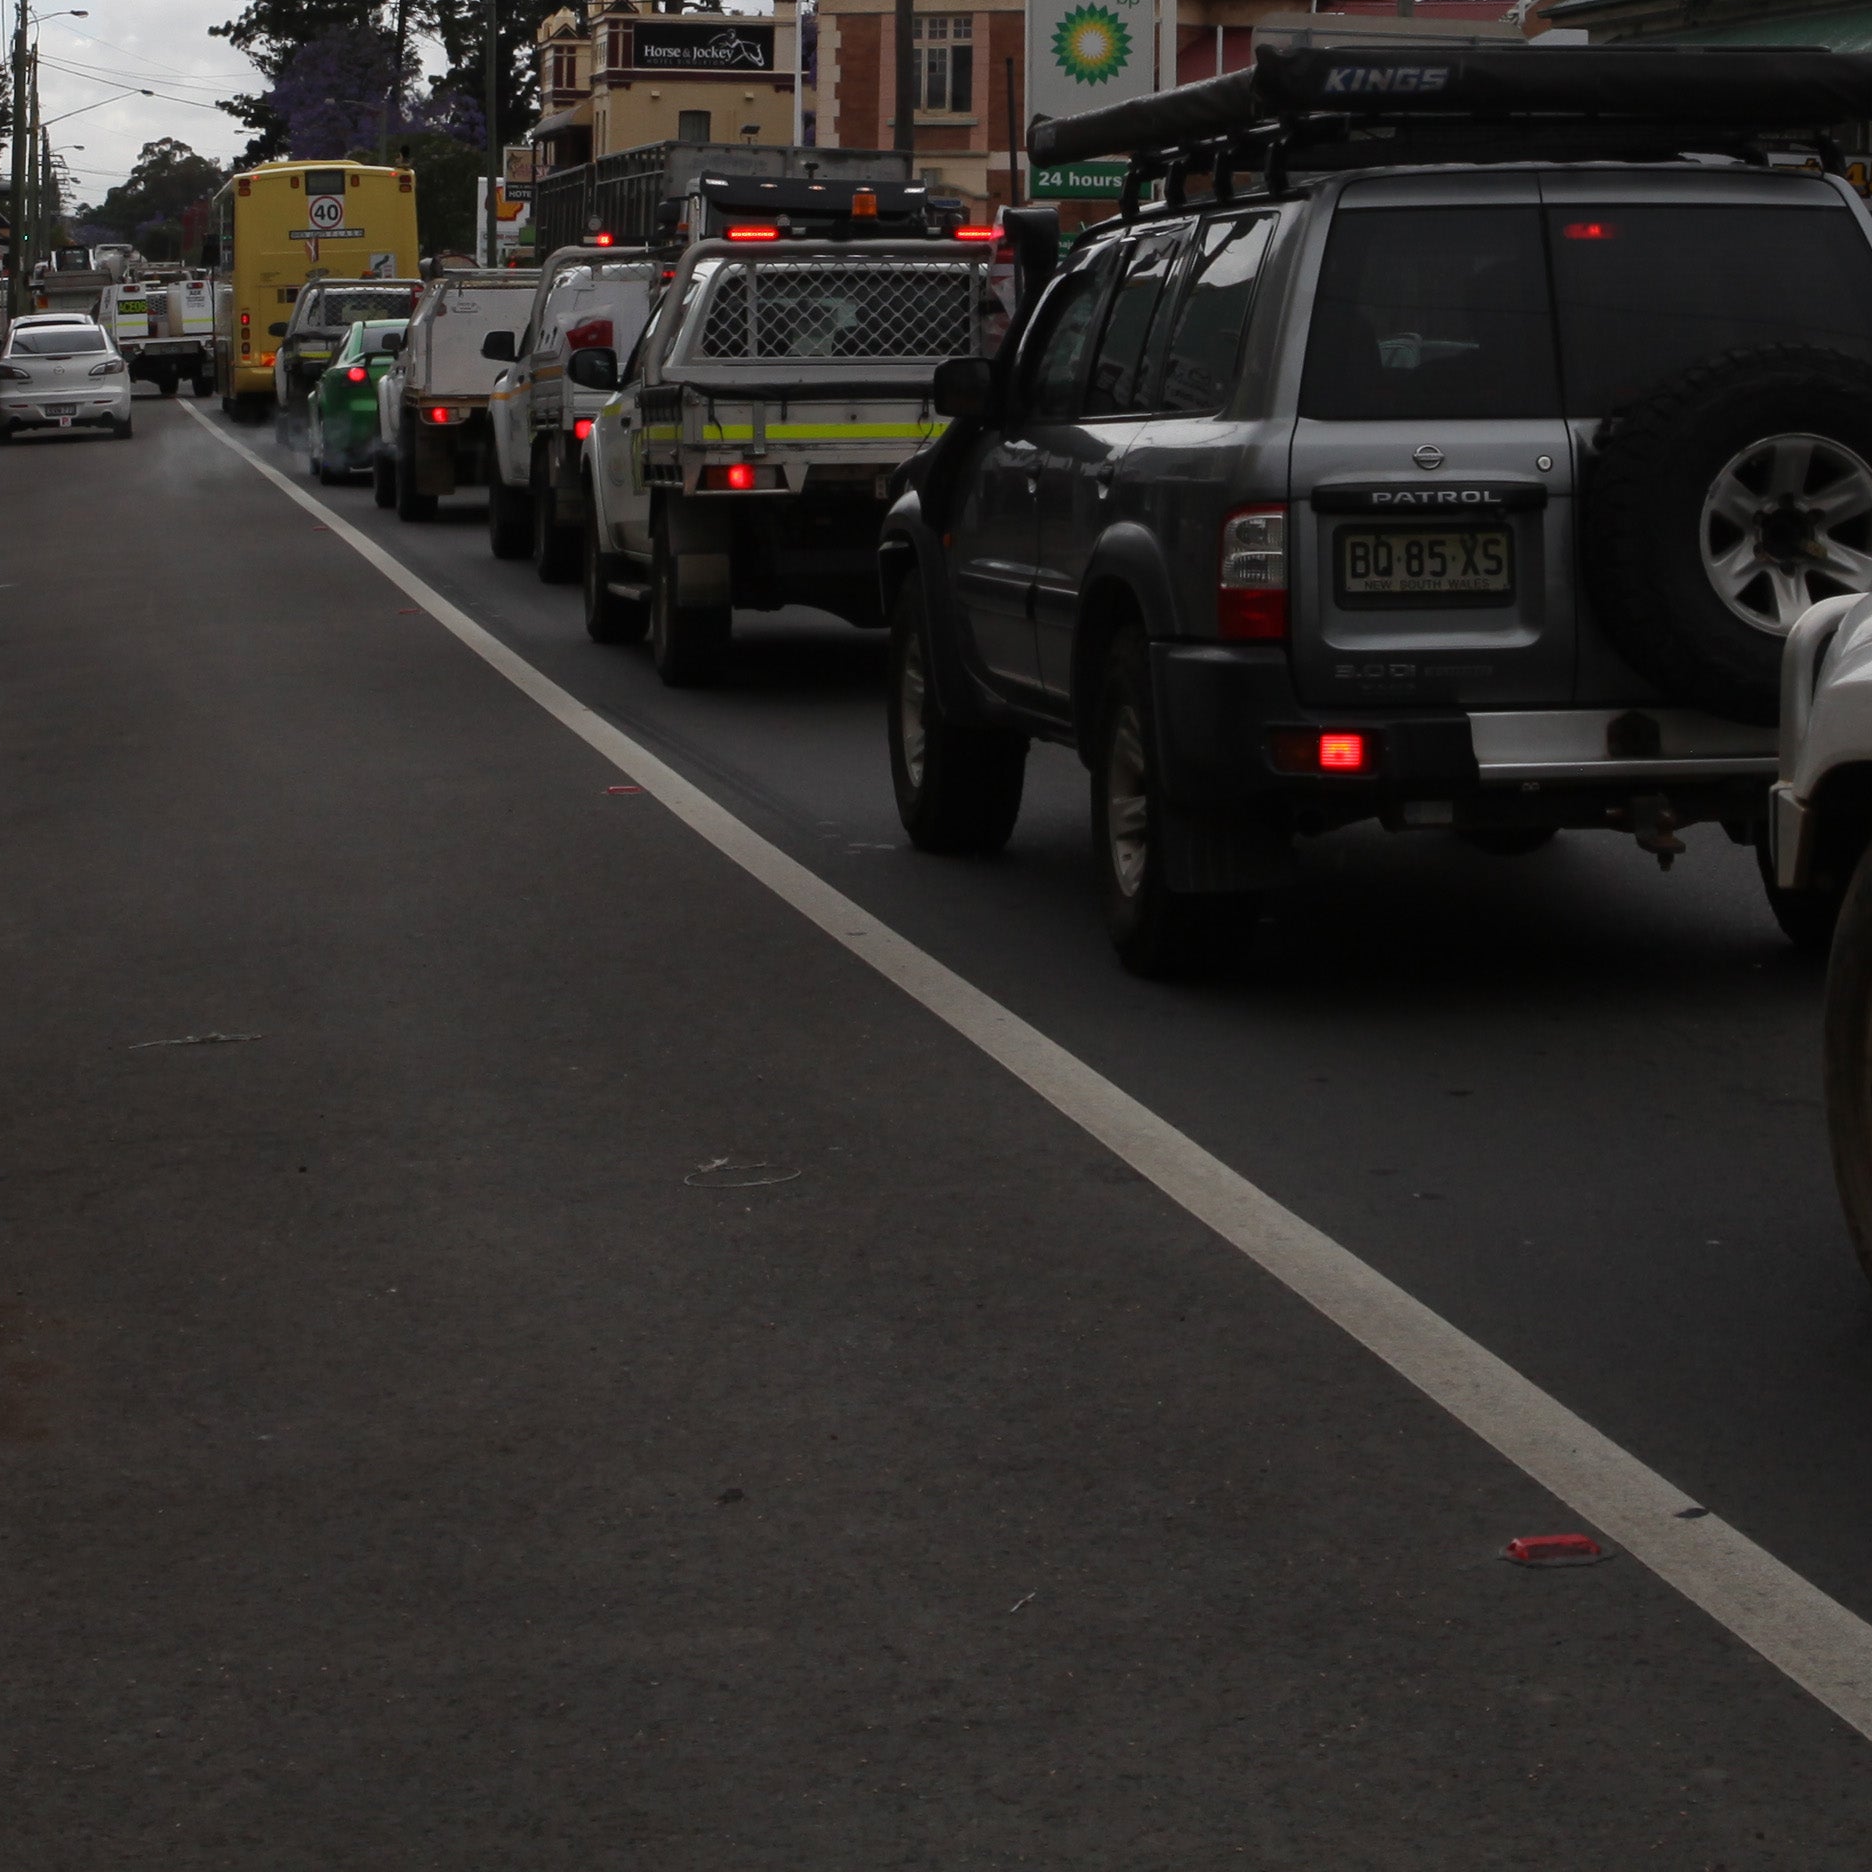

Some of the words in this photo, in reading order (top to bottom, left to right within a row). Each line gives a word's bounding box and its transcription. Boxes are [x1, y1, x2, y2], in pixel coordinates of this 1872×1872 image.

[644, 45, 681, 58] Horse
[692, 45, 734, 61] Jockey
[1324, 65, 1450, 95] KINGS
[1038, 171, 1063, 187] 24
[1068, 170, 1123, 188] hours
[314, 204, 339, 221] 40
[1371, 490, 1503, 504] PATROL
[1365, 580, 1393, 591] NEW
[1399, 579, 1442, 590] SOUTH
[1448, 578, 1491, 589] WALES
